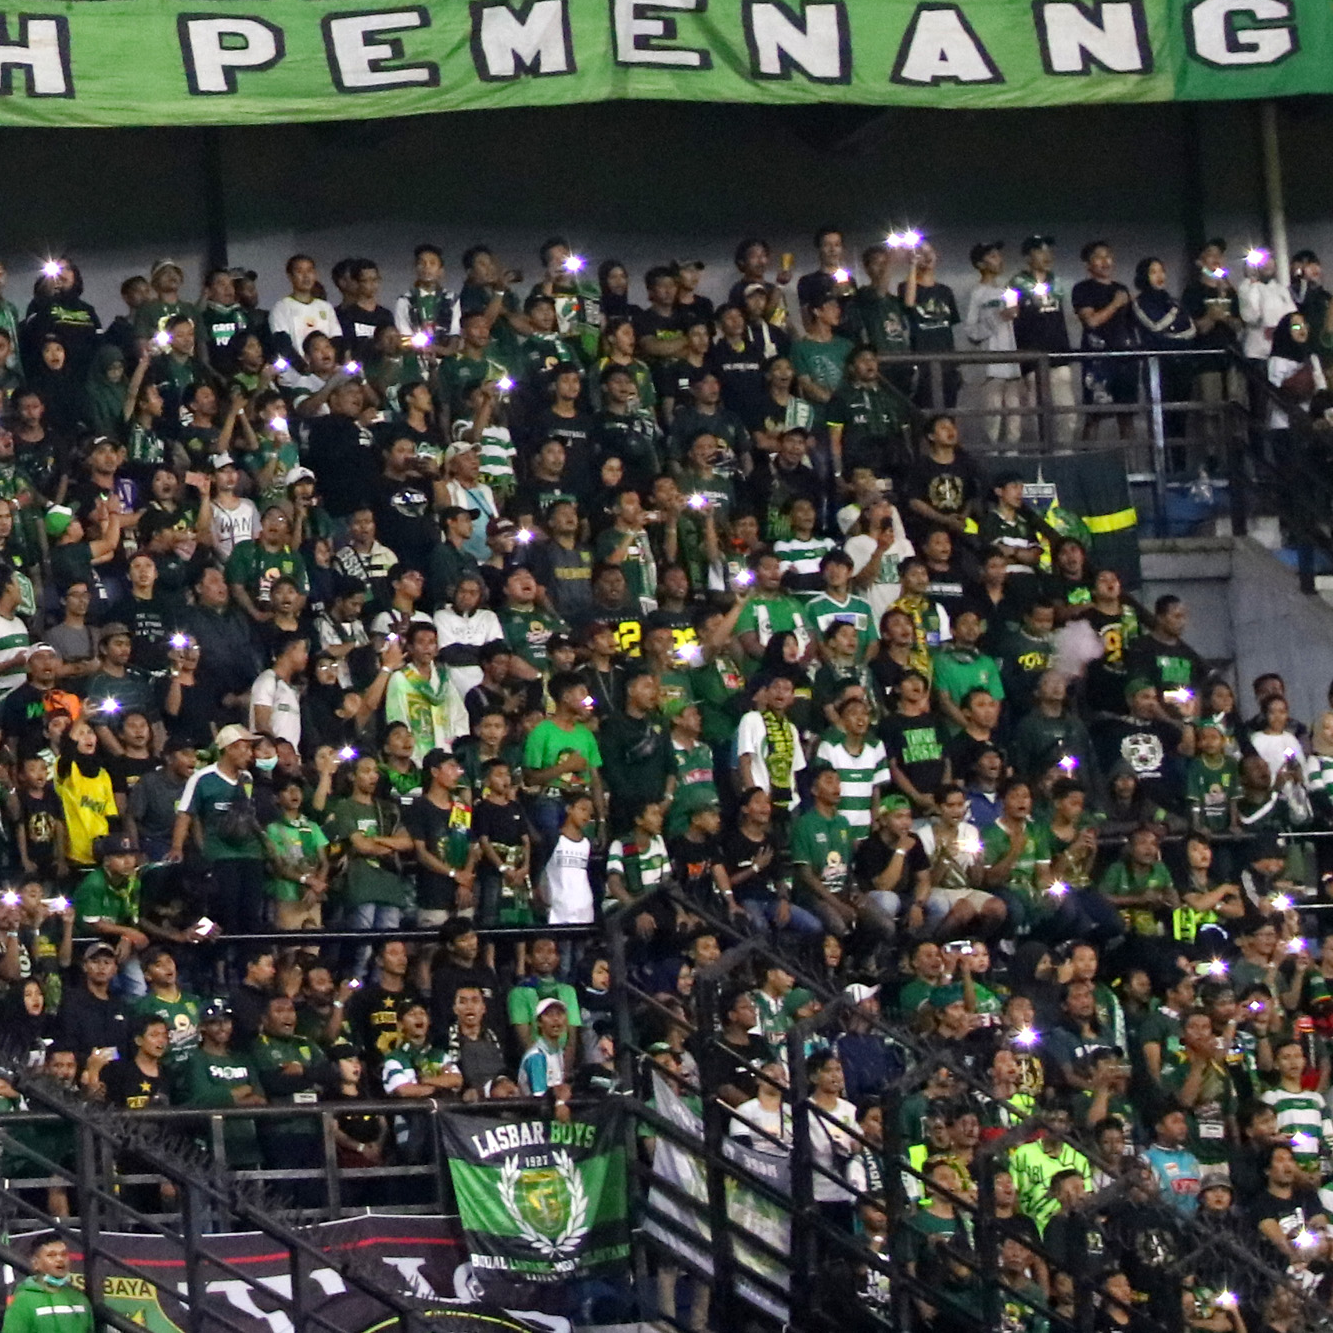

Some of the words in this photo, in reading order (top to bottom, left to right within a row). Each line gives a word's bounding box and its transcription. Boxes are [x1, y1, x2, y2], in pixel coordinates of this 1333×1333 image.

[471, 1120, 545, 1159] LASBAR
[550, 1120, 596, 1148] BOYS
[525, 1154, 549, 1168] 1927
